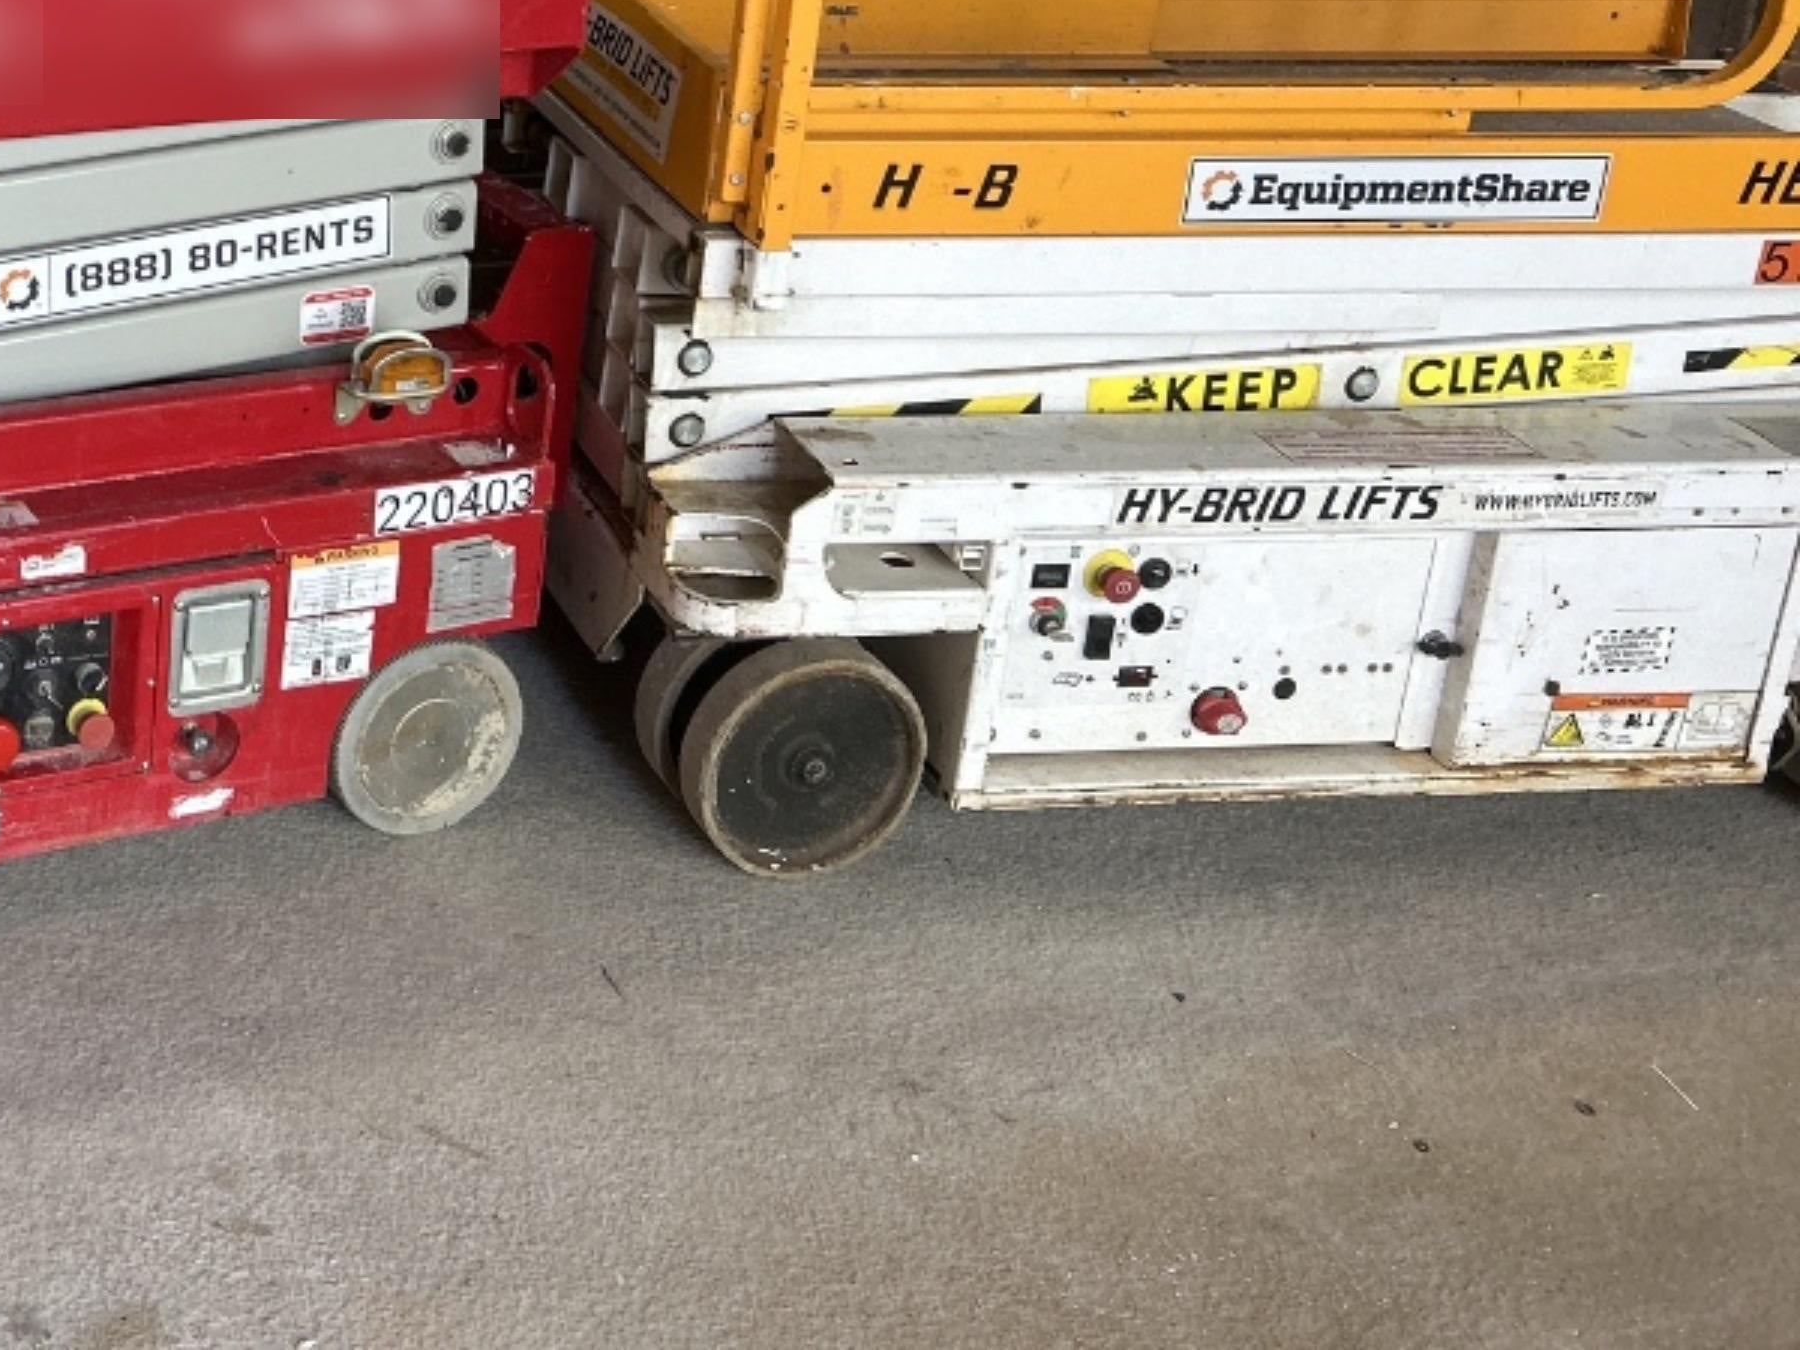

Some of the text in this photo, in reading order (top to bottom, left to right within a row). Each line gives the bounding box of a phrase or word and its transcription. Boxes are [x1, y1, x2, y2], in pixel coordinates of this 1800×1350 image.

[1247, 172, 1592, 211] EquipmentShare
[64, 214, 376, 298] (888) 80-RENTS
[1164, 368, 1298, 411] KEEP
[1407, 350, 1565, 398] CLEAR
[376, 473, 534, 534] 220403
[1115, 486, 1446, 524] HY-BRID LIFTS
